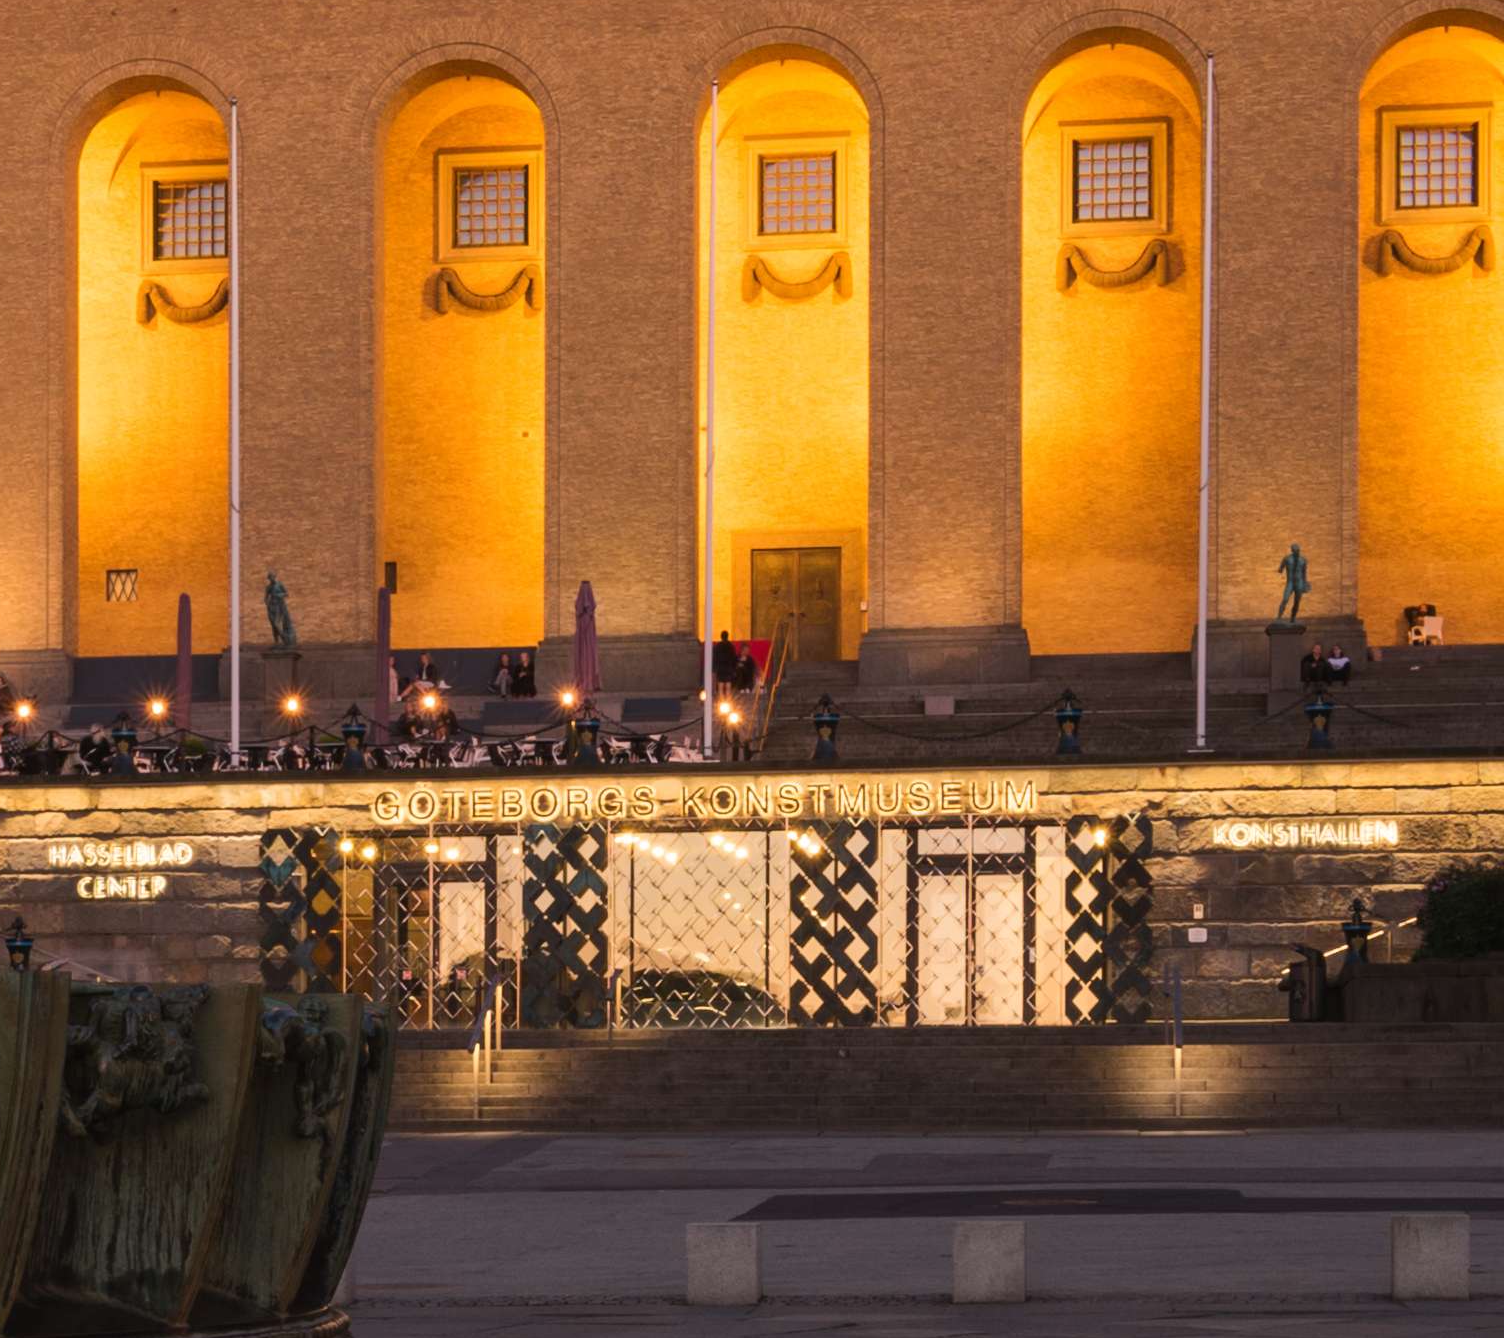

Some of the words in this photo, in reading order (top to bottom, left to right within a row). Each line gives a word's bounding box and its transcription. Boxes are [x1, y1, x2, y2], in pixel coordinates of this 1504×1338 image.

[372, 781, 657, 822] GÖTEBORGS
[680, 779, 1037, 817] KONSTMUSEUM
[1212, 820, 1399, 847] KONSTHALLEN
[47, 841, 194, 868] HASSELBLAD
[75, 874, 168, 900] CENTER
